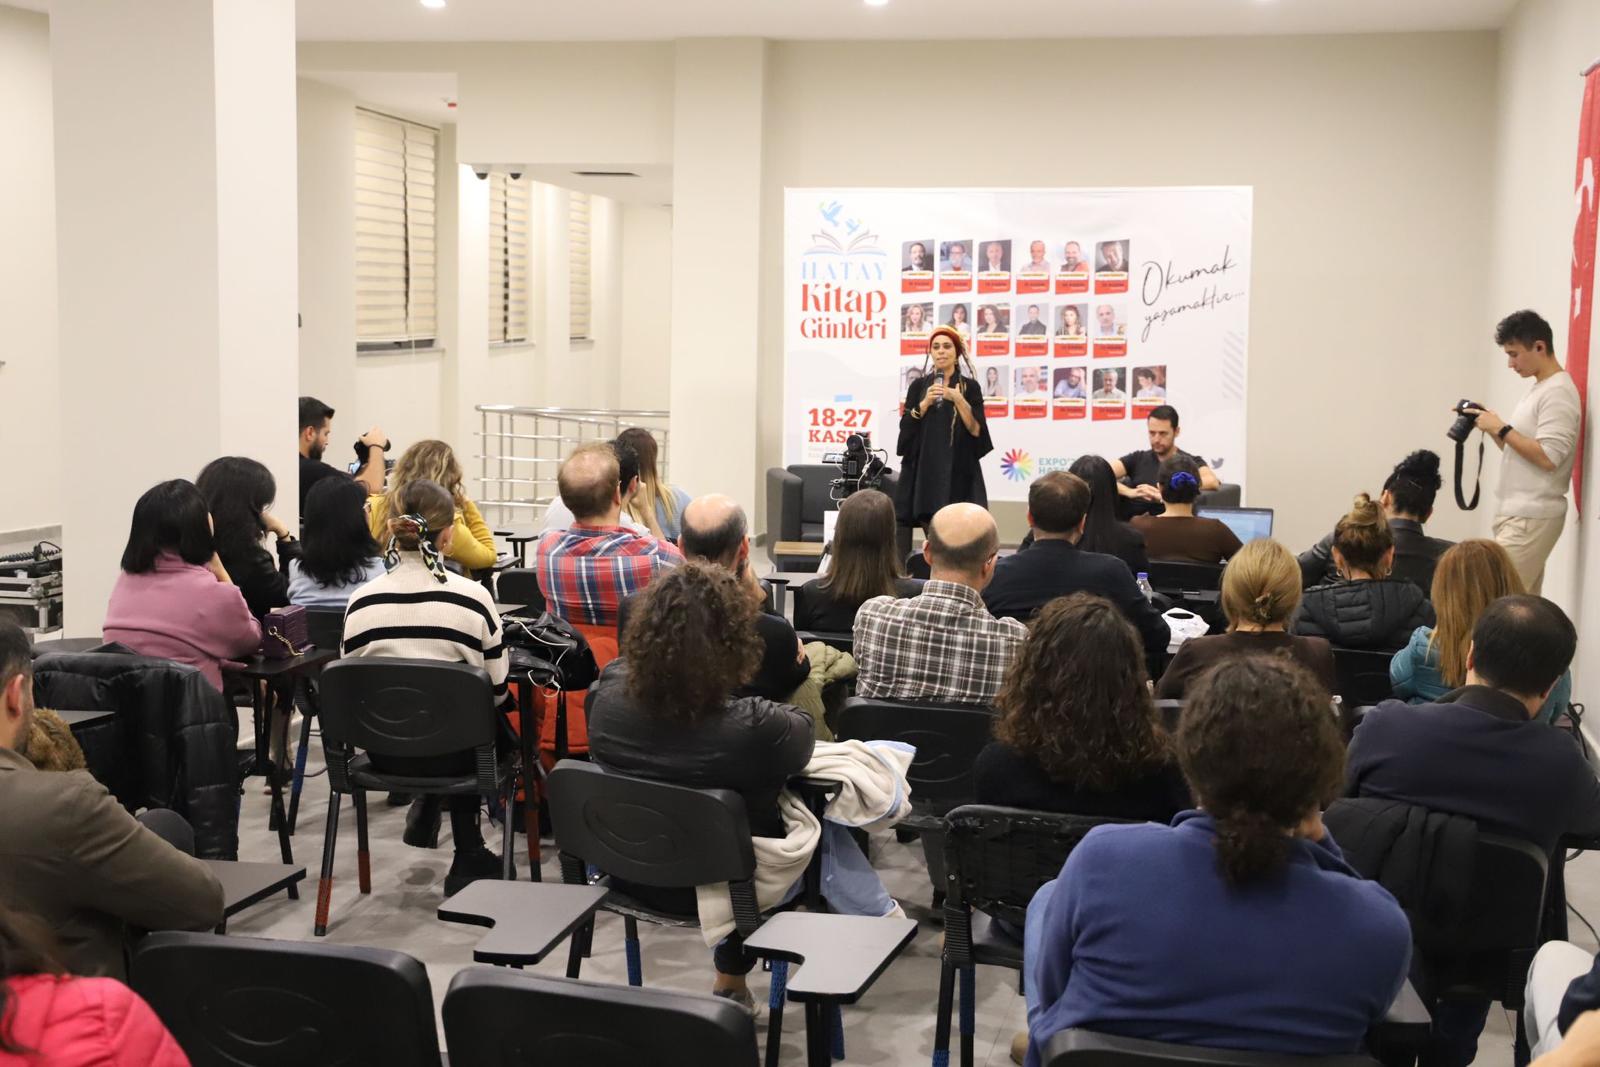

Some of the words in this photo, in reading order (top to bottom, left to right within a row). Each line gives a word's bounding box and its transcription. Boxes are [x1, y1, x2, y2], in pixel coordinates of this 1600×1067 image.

[802, 261, 886, 280] HATAY
[1142, 244, 1238, 306] Okumak
[802, 282, 887, 321] Kitap
[800, 317, 886, 340] Günleri
[808, 408, 872, 428] 18-27
[808, 430, 872, 443] KAS
